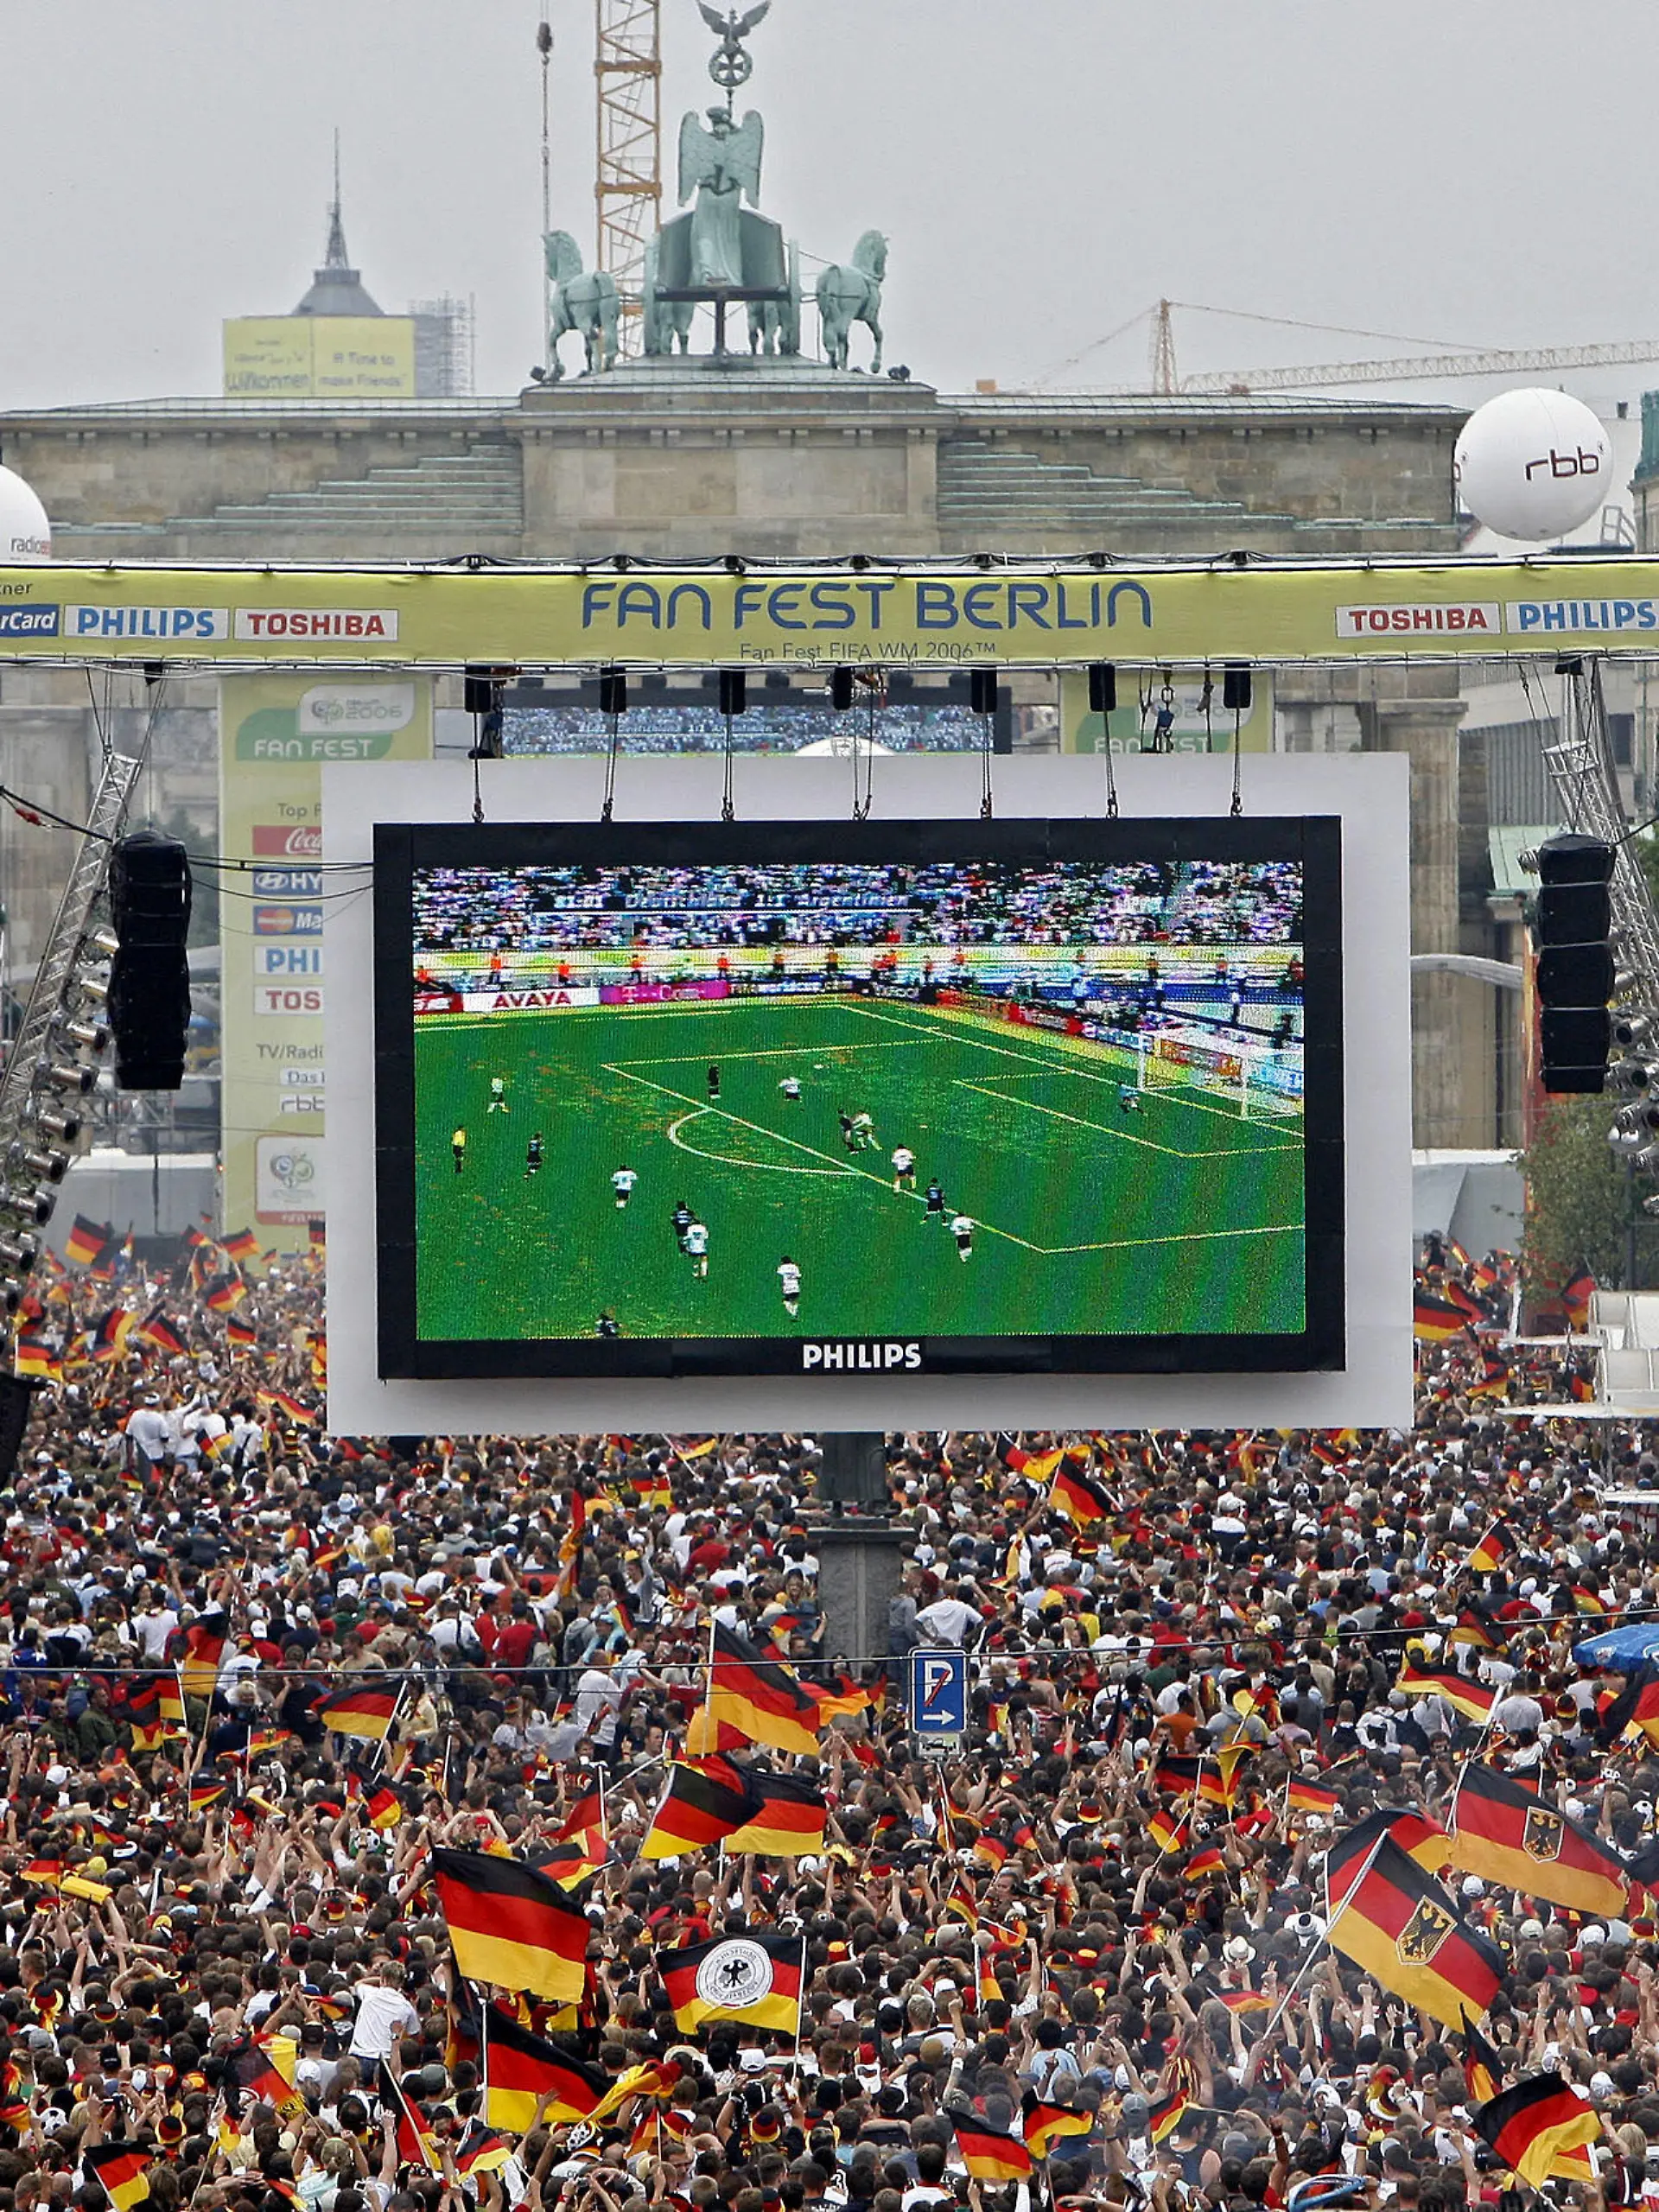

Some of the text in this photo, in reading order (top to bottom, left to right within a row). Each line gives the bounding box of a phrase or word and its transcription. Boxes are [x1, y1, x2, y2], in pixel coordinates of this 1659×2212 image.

[1525, 446, 1599, 481] rbb
[582, 581, 1153, 631] FAN FEST BERLIN
[1519, 601, 1657, 631] PHILIPS
[77, 607, 215, 638] PHILIPS
[247, 613, 385, 636] TOSHIBA
[1349, 607, 1488, 631] TOSHIBA
[740, 642, 774, 660] Fan
[782, 642, 822, 659] Fest
[830, 642, 872, 659] FIFA
[878, 642, 918, 659] WM
[254, 738, 373, 758] FAN FEST
[277, 802, 308, 821] Top
[265, 949, 320, 973] PHI
[265, 989, 321, 1010] TOS
[492, 990, 572, 1009] AVAYA
[802, 1343, 922, 1369] PHILIPS
